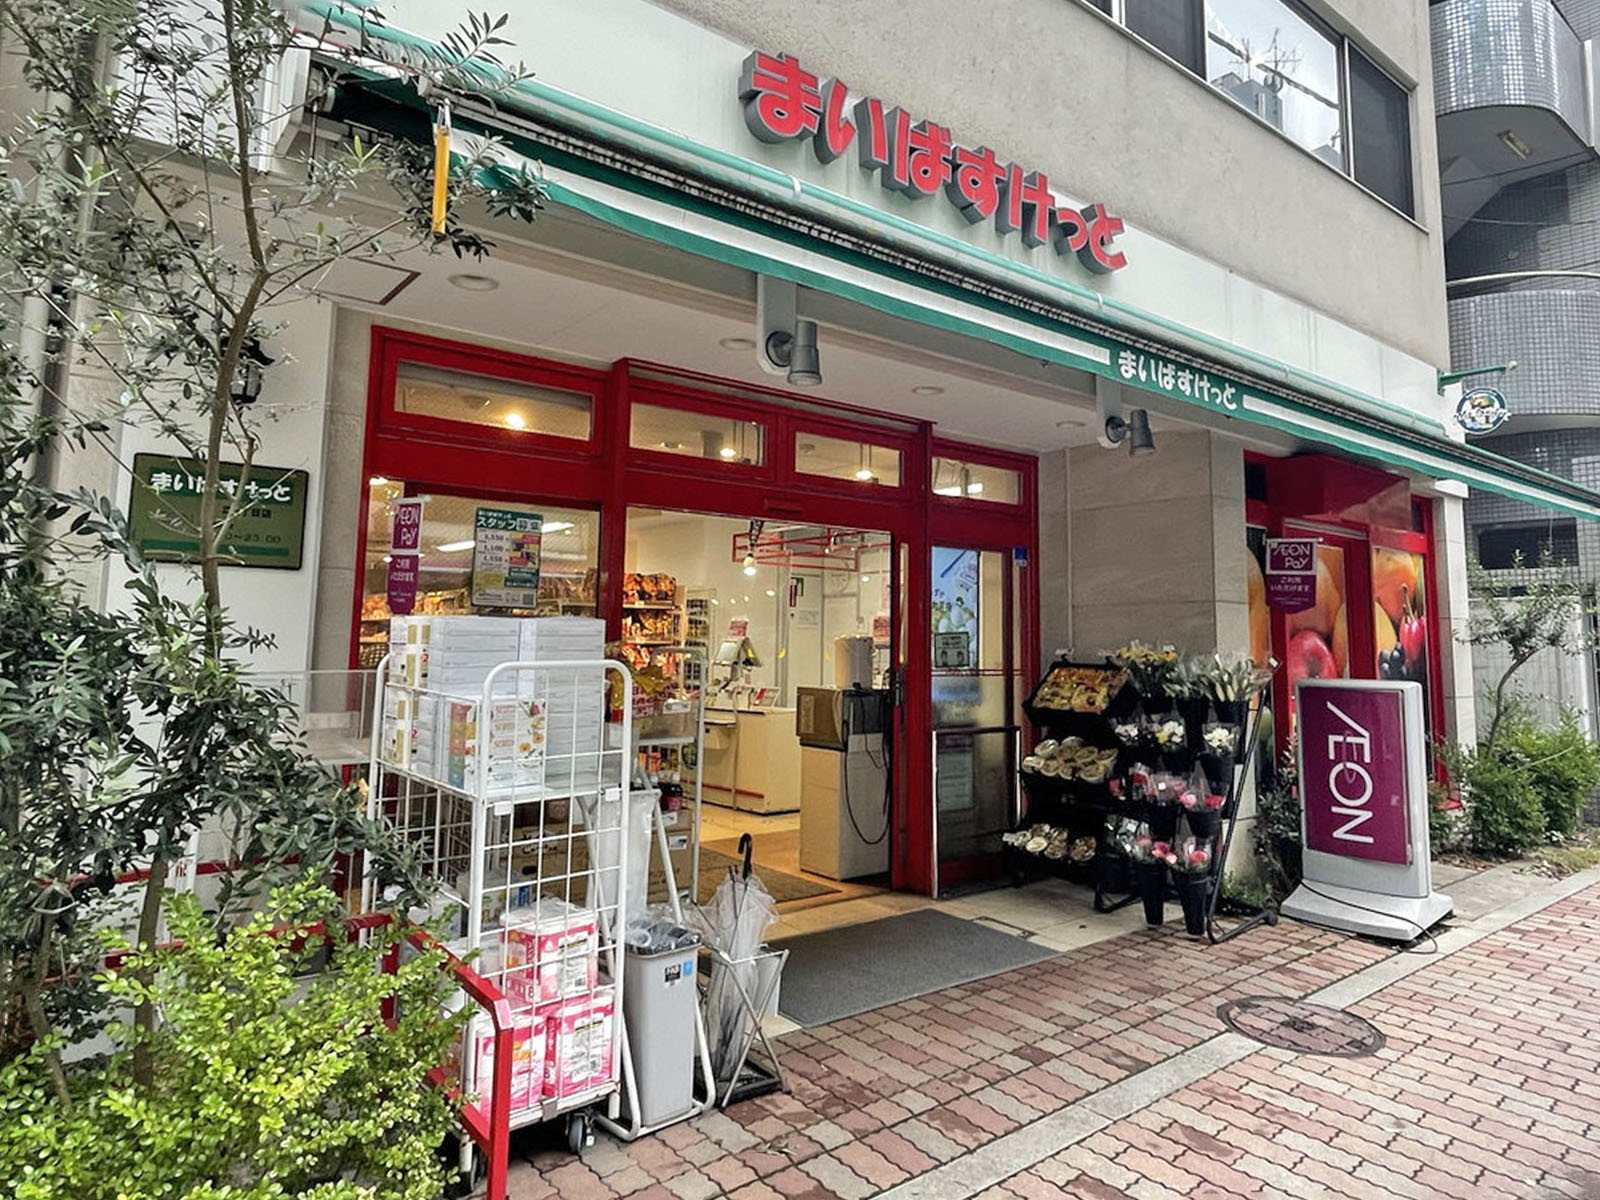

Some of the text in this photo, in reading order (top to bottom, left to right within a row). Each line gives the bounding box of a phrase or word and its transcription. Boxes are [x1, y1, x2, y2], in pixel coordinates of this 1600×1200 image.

[740, 49, 1129, 275] まいばすけっと
[1117, 349, 1238, 411] まいばすけっと
[1272, 543, 1311, 556] AEON
[1325, 700, 1375, 844] AEON
